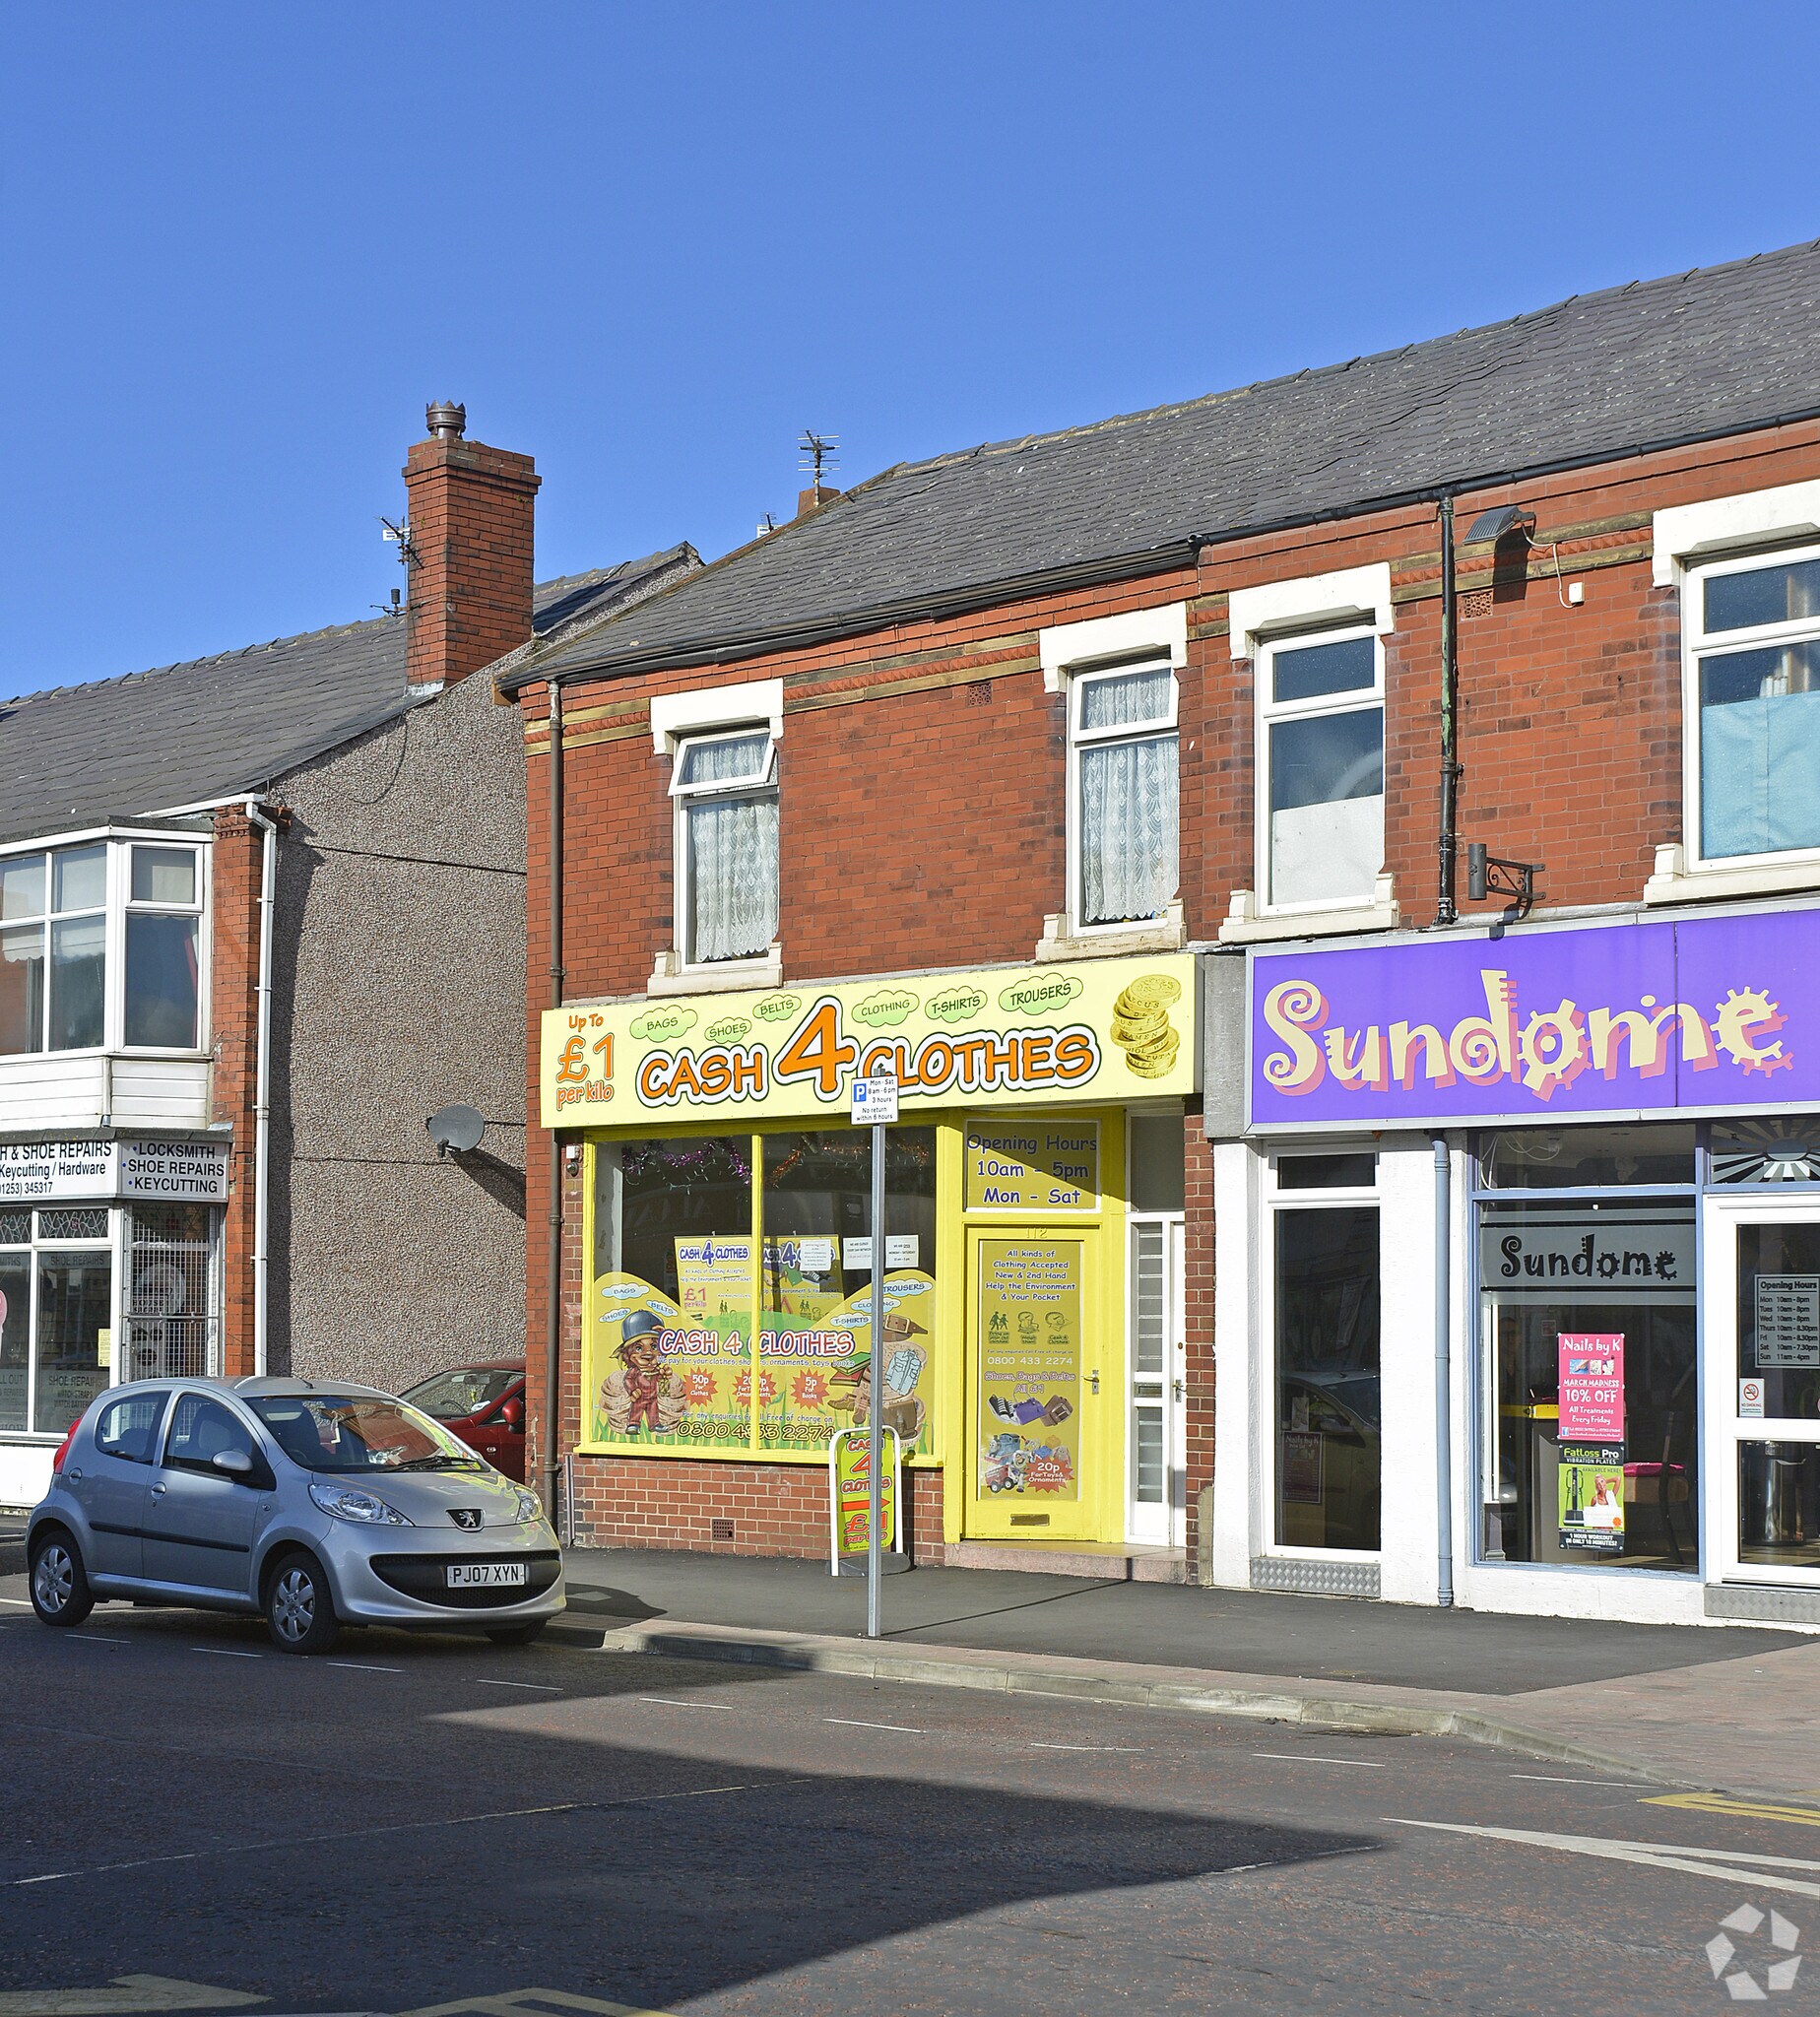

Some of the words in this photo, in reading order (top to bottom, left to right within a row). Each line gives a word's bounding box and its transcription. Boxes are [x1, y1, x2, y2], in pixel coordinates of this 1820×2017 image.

[1010, 983, 1072, 1007] TROUSERS
[760, 1000, 794, 1015] BELTS
[861, 1000, 910, 1016] CLOTHING
[932, 996, 981, 1014] T-SHIRTS
[568, 1015, 586, 1032] Up
[589, 1013, 604, 1027] To
[646, 1017, 679, 1031] BAGS
[709, 1022, 748, 1038] SHOES
[1264, 969, 1788, 1095] Sundome
[556, 1033, 615, 1083] £1
[638, 1048, 767, 1103] CASH
[776, 1000, 858, 1097] 4
[860, 1029, 1098, 1093] CLOTHES
[556, 1087, 584, 1111] per
[585, 1079, 615, 1102] kilo
[12, 1146, 19, 1160] &
[23, 1143, 55, 1159] SHOE
[59, 1140, 111, 1158] REPAIRS
[139, 1142, 215, 1159] LOCKSMITH
[967, 1135, 1037, 1153] Opening
[1046, 1135, 1097, 1150] Hours
[0, 1160, 50, 1181] Keycutting
[59, 1160, 105, 1176] Hardware
[128, 1159, 164, 1173] SHOE
[169, 1162, 225, 1176] REPAIRS
[977, 1161, 1024, 1177] 10am
[1053, 1162, 1088, 1181] 5pm
[25, 1182, 53, 1194] 345317
[134, 1177, 218, 1193] KEYCUTTING
[984, 1188, 1020, 1203] Mon
[1048, 1189, 1080, 1204] Sat
[680, 1248, 700, 1260] CASH
[701, 1241, 715, 1266] 4
[715, 1247, 749, 1260] CLOTHES
[1501, 1233, 1677, 1280] Sundome
[993, 1261, 1026, 1269] Clothing
[1030, 1261, 1069, 1269] Accepted
[1760, 1280, 1792, 1290] Opening
[684, 1287, 706, 1301] £1
[602, 1310, 628, 1321] SHOES
[651, 1302, 674, 1314] BELTS
[660, 1331, 717, 1353] CASH
[724, 1332, 742, 1354] 4
[749, 1332, 853, 1355] CLOTHES
[1563, 1336, 1593, 1352] Nails
[1595, 1338, 1610, 1355] by
[1612, 1338, 1621, 1351] K
[709, 1357, 737, 1366] clothes,
[987, 1356, 1015, 1365] 0800
[1019, 1356, 1041, 1365] 433
[692, 1375, 709, 1387] 50p
[806, 1377, 817, 1388] 5p
[1016, 1371, 1040, 1383] Bags
[1014, 1384, 1027, 1393] All
[1565, 1389, 1592, 1402] 10%
[1594, 1390, 1618, 1402] OFF
[1572, 1415, 1590, 1424] Every
[1591, 1415, 1611, 1425] Friday
[678, 1421, 730, 1438] 0800
[782, 1424, 835, 1441] 2274
[1564, 1448, 1599, 1457] FatLoss
[1601, 1449, 1620, 1458] Pro
[1037, 1463, 1060, 1473] 20p
[844, 1534, 865, 1546] per
[453, 1566, 489, 1583] PJ07
[493, 1565, 519, 1582] XYN
